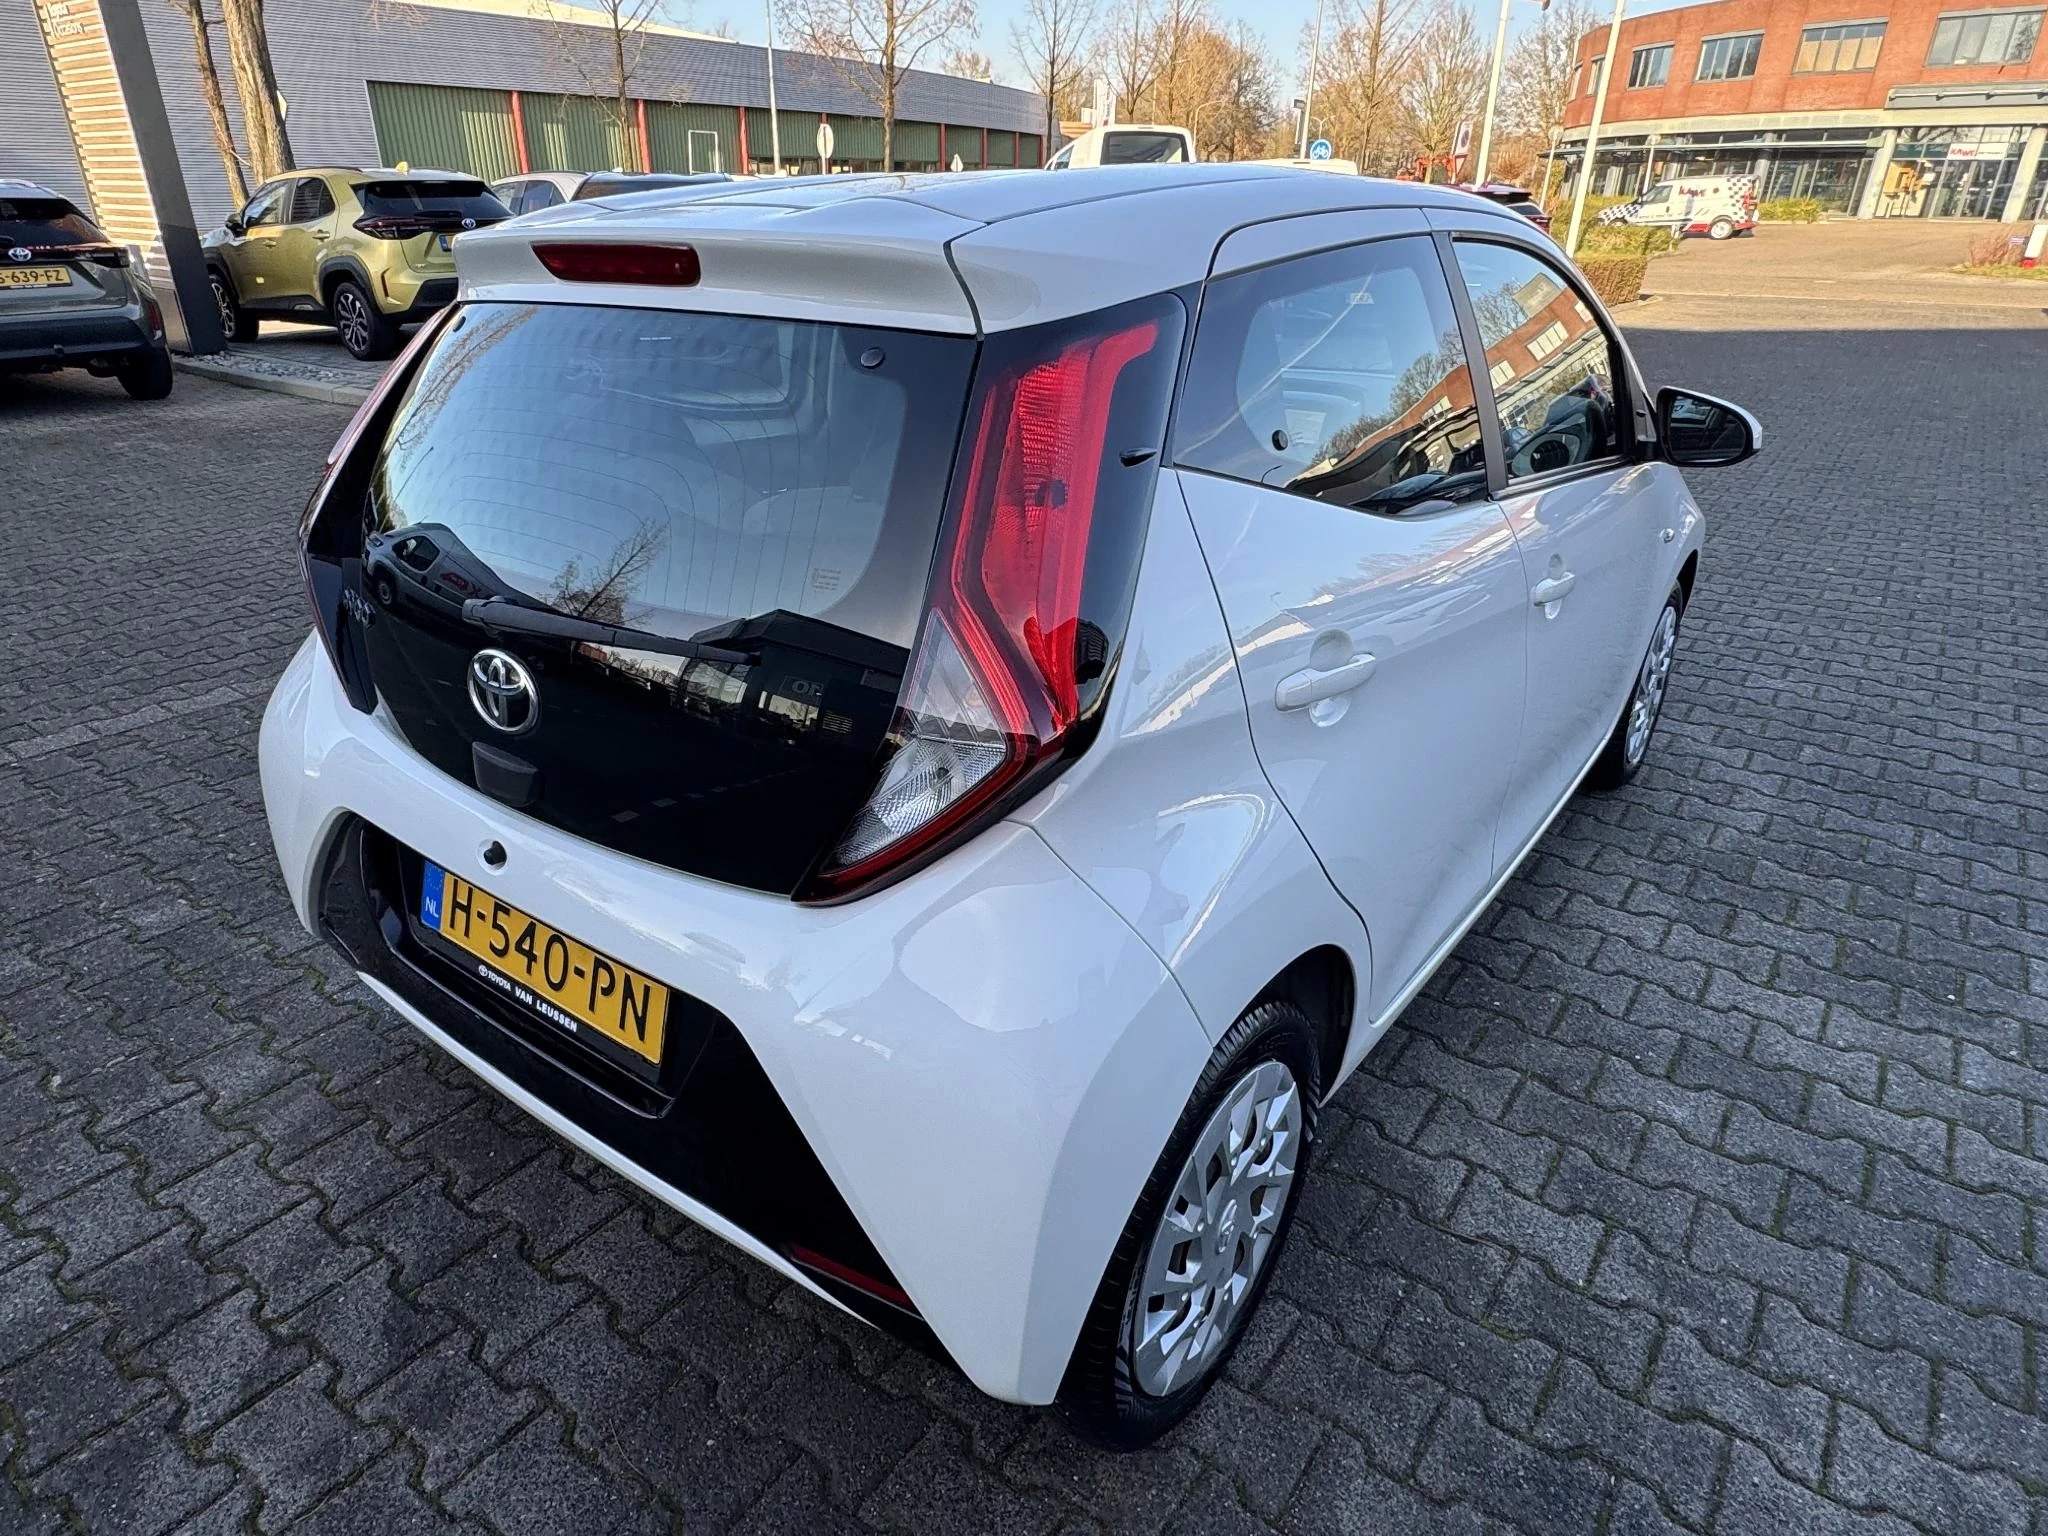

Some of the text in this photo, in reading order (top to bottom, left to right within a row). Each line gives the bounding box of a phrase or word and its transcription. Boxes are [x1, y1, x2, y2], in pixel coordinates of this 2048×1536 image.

[425, 896, 439, 918] NL
[450, 878, 650, 1042] H-540-PN
[486, 970, 577, 1033] TOYOTA VAN LEUSSEN
